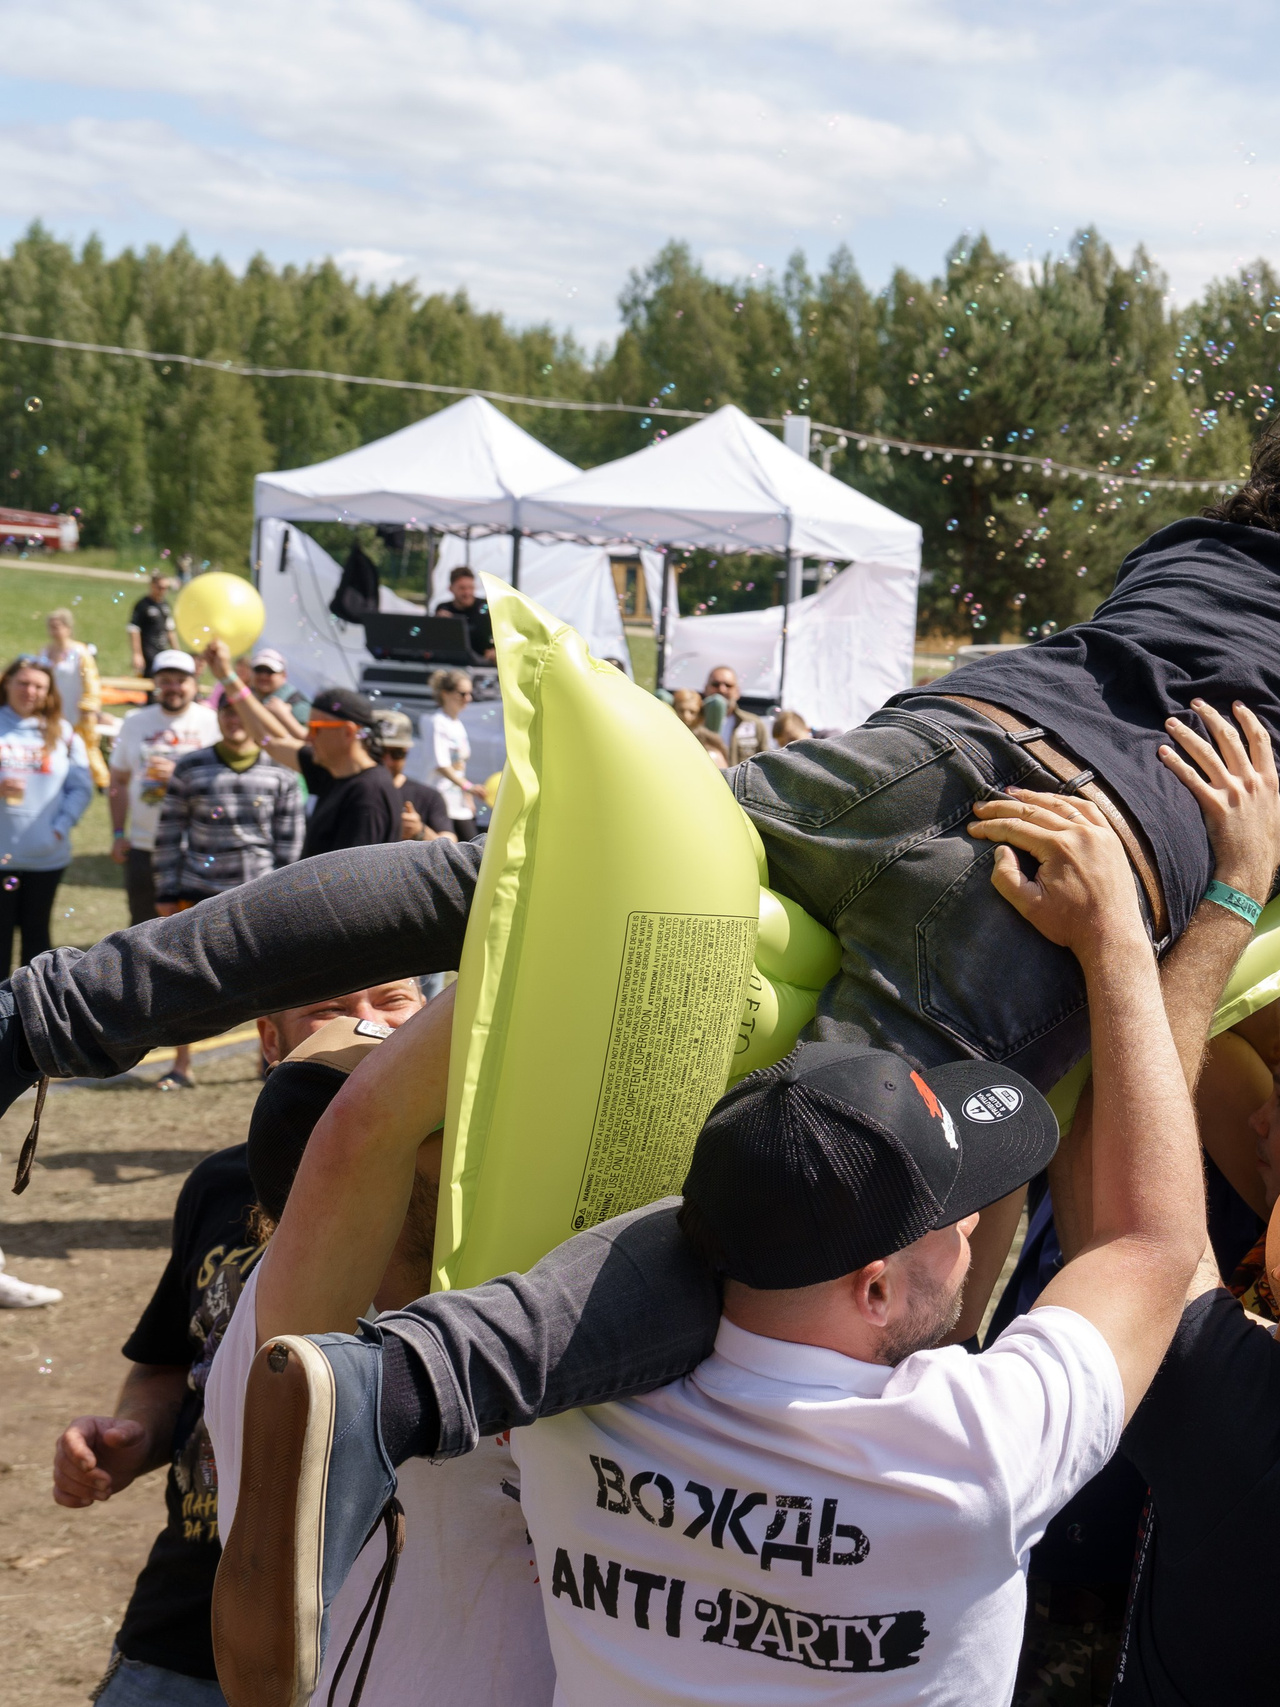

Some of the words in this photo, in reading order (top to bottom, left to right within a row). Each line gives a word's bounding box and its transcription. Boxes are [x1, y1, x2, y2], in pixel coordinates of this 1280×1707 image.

[630, 922, 638, 945] DEVICE
[638, 914, 647, 936] WATER
[627, 945, 635, 965] WHILE
[641, 942, 651, 970] SERIOUS
[653, 930, 664, 962] N'UTILISER
[634, 950, 642, 968] NEAR
[621, 965, 632, 1006] UNATTENDED
[638, 971, 647, 993] OTHER
[647, 969, 658, 1005] ATTENTION!
[628, 986, 637, 1006] LEAVE
[618, 1007, 626, 1025] CHILD
[625, 1006, 634, 1028] NEVER
[630, 1004, 642, 1039] PARALYSIS
[614, 1026, 623, 1046] LEAVE
[634, 1006, 653, 1065] SUPERVISION.
[617, 1060, 625, 1074] THIS
[614, 1075, 622, 1089] INTO
[620, 1077, 629, 1096] AVOID
[623, 1067, 642, 1117] COMPETENT
[601, 1094, 611, 1117] SAVING
[610, 1090, 619, 1111] DIVING
[598, 1118, 606, 1131] LIFE
[605, 1111, 615, 1132] ALLOW
[614, 1107, 623, 1127] RULES
[601, 1133, 611, 1153] NEVER
[609, 1129, 619, 1148] THESE
[617, 1118, 632, 1147] UNDER
[589, 1157, 598, 1171] THIS
[603, 1149, 614, 1174] FOLLOW
[611, 1149, 625, 1170] ONLY
[582, 1171, 594, 1201] WARNING:
[588, 1194, 596, 1207] THIS
[589, 1454, 870, 1577] ВОЖДЬ
